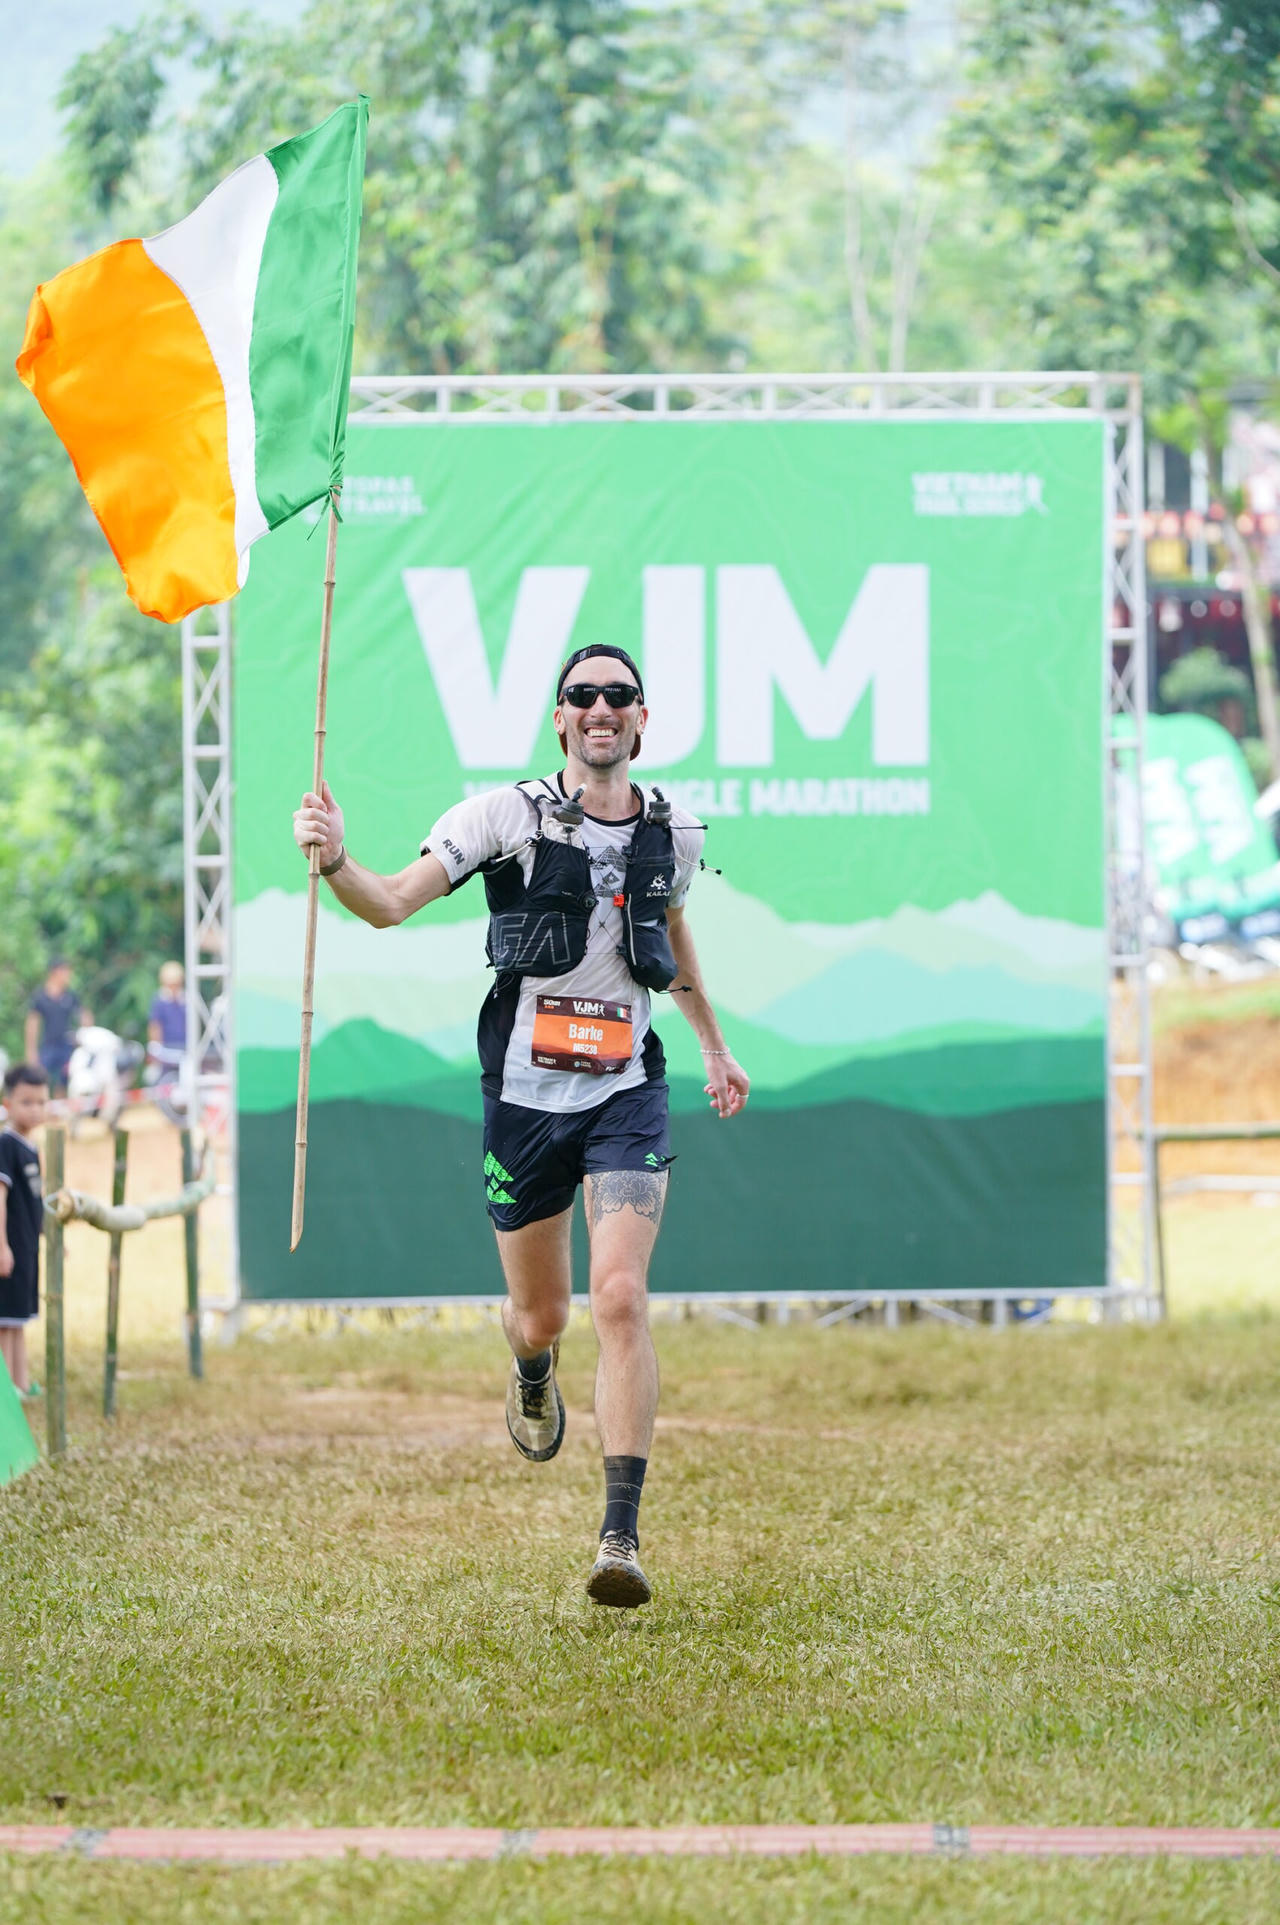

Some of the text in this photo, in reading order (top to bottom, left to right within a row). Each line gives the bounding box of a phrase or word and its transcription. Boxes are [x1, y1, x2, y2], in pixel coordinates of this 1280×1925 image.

[403, 564, 929, 770] VJM
[752, 778, 929, 816] MARATHON
[442, 838, 465, 865] RUN
[573, 1001, 599, 1013] VJM
[569, 1024, 603, 1041] Barke
